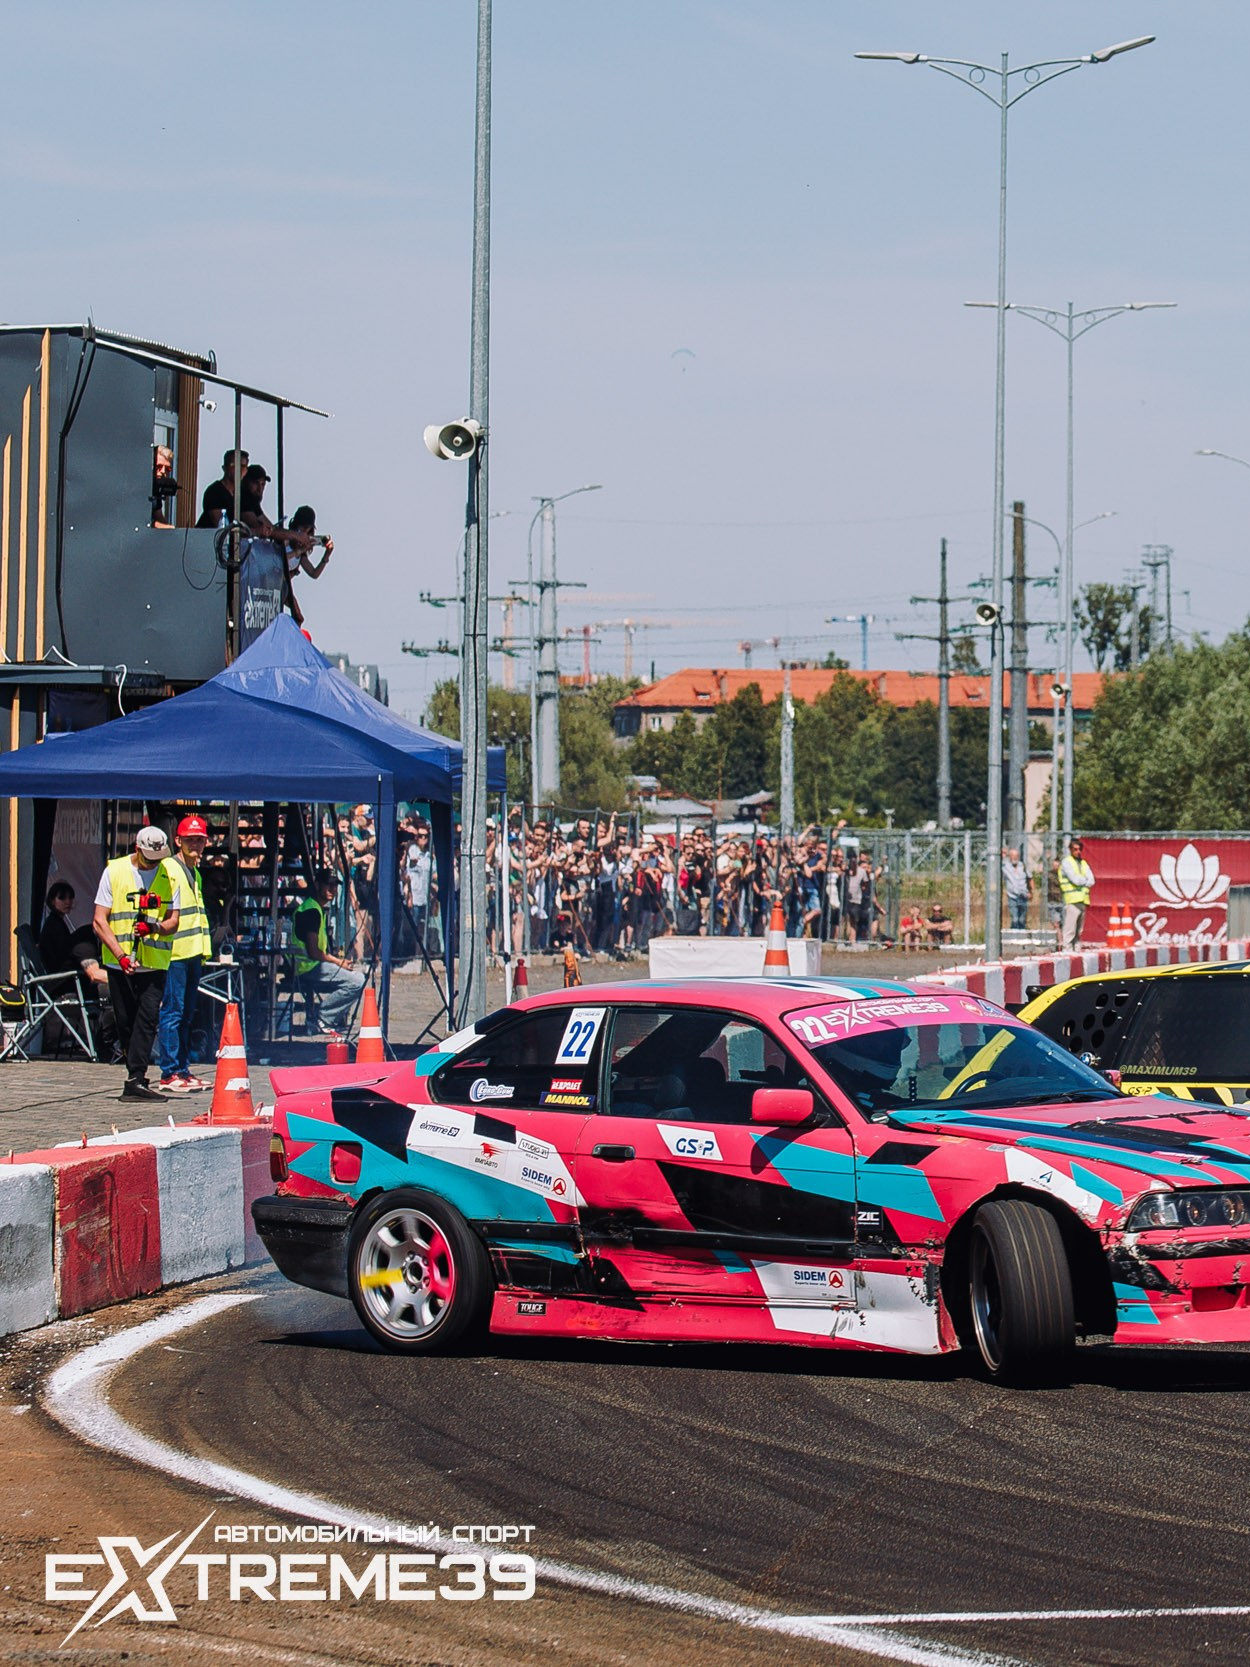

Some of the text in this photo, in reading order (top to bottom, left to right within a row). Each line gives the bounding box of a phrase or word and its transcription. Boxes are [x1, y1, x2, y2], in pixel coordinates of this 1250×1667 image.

[1134, 912, 1228, 945] Shambal
[790, 1016, 838, 1043] 22
[823, 1001, 950, 1034] EXTREME39
[562, 1021, 595, 1057] 22
[1120, 1064, 1197, 1076] @MAXIMUM39
[545, 1095, 590, 1106] MANNOL
[522, 1167, 552, 1185] SIDEM
[857, 1212, 880, 1221] ZIC
[794, 1270, 826, 1281] SIDEM
